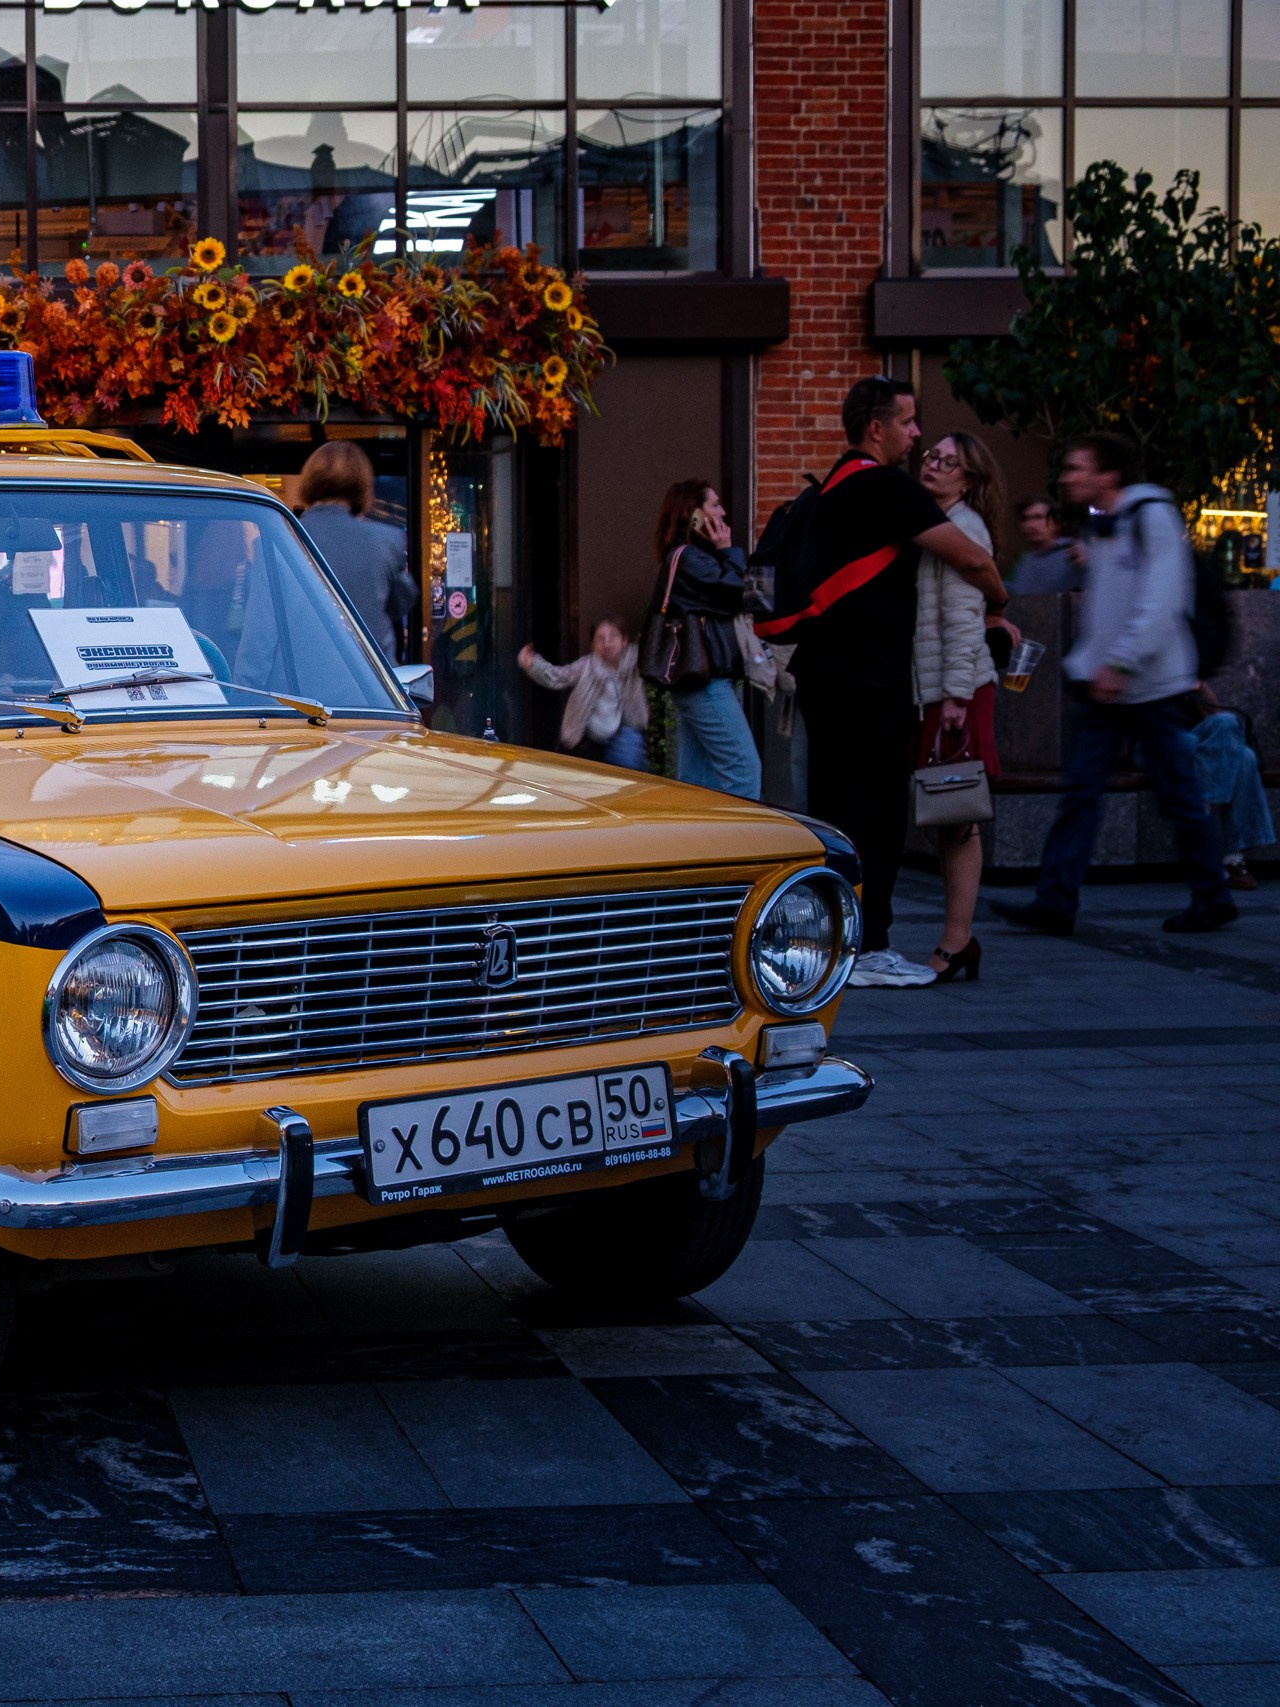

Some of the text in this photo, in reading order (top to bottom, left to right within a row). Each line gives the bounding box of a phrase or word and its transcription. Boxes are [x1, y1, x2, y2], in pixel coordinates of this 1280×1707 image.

[79, 645, 169, 659] ЭКСПОНАТ
[86, 661, 124, 670] РУКАМИ
[139, 660, 176, 668] ТРОГАТЬ
[604, 1075, 651, 1122] 50
[606, 1124, 640, 1142] RUS
[605, 1147, 671, 1166] 8(916)166-88-88
[482, 1163, 582, 1186] www.RETROGARAG.ru
[381, 1185, 442, 1201] Ретро Гараж
